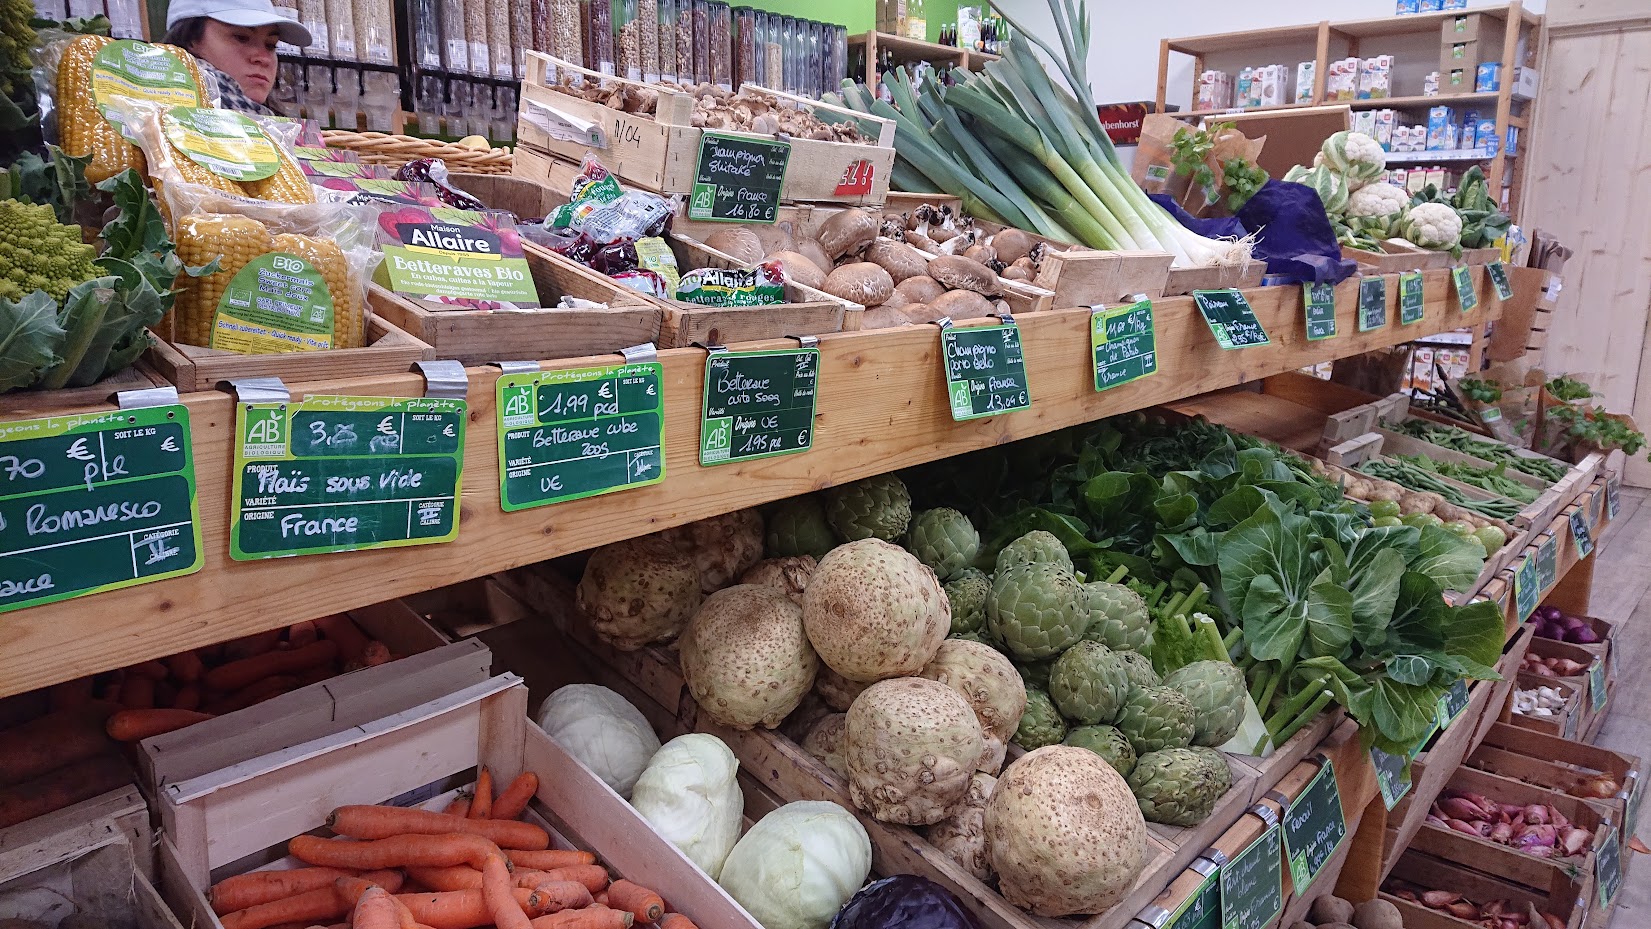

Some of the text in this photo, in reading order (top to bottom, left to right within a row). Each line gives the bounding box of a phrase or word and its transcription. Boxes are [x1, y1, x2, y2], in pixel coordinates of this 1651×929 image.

[694, 191, 710, 207] AB
[765, 206, 773, 219] €
[430, 224, 461, 234] Maison
[411, 228, 491, 253] Allaire
[273, 256, 304, 273] BIO
[393, 256, 524, 282] Betteraves Bio
[411, 272, 421, 280] En
[258, 276, 312, 294] Sweet corn
[285, 290, 309, 301] doux
[218, 320, 239, 330] Schnell
[239, 324, 266, 335] zubereitet
[271, 330, 287, 339] Quick
[287, 334, 302, 344] ready
[306, 337, 317, 346] Vite
[541, 365, 653, 382] Protégeons la planète
[304, 395, 455, 411] Protégeons la planète
[505, 395, 529, 415] AB
[539, 392, 588, 416] 1,99
[597, 382, 613, 399] €
[646, 384, 656, 395] €
[1019, 391, 1026, 404] €
[47, 418, 60, 429] la
[66, 414, 124, 431] planète
[377, 416, 397, 434] €
[442, 424, 456, 437] €
[761, 415, 778, 428] UE
[248, 420, 280, 443] AB
[507, 431, 531, 440] PRODUIT
[533, 427, 599, 448] Betterave
[706, 428, 726, 449] AB
[797, 430, 808, 445] €
[66, 437, 95, 460] €
[114, 431, 133, 439] SOIT
[134, 429, 144, 437] LE
[146, 428, 156, 437] KG
[160, 436, 180, 452] €
[247, 465, 278, 473] PRODUIT
[508, 456, 532, 466] VARIÉTÉ
[258, 470, 311, 494] Maïs
[325, 476, 370, 493] sous
[508, 469, 563, 492] ORIGINE UE
[245, 496, 277, 506] VARIÉTÉ
[418, 501, 444, 509] CATÉGORIE
[26, 500, 161, 535] Romanesco
[244, 511, 359, 538] ORIGINE France
[143, 528, 180, 541] CATÉGORIE
